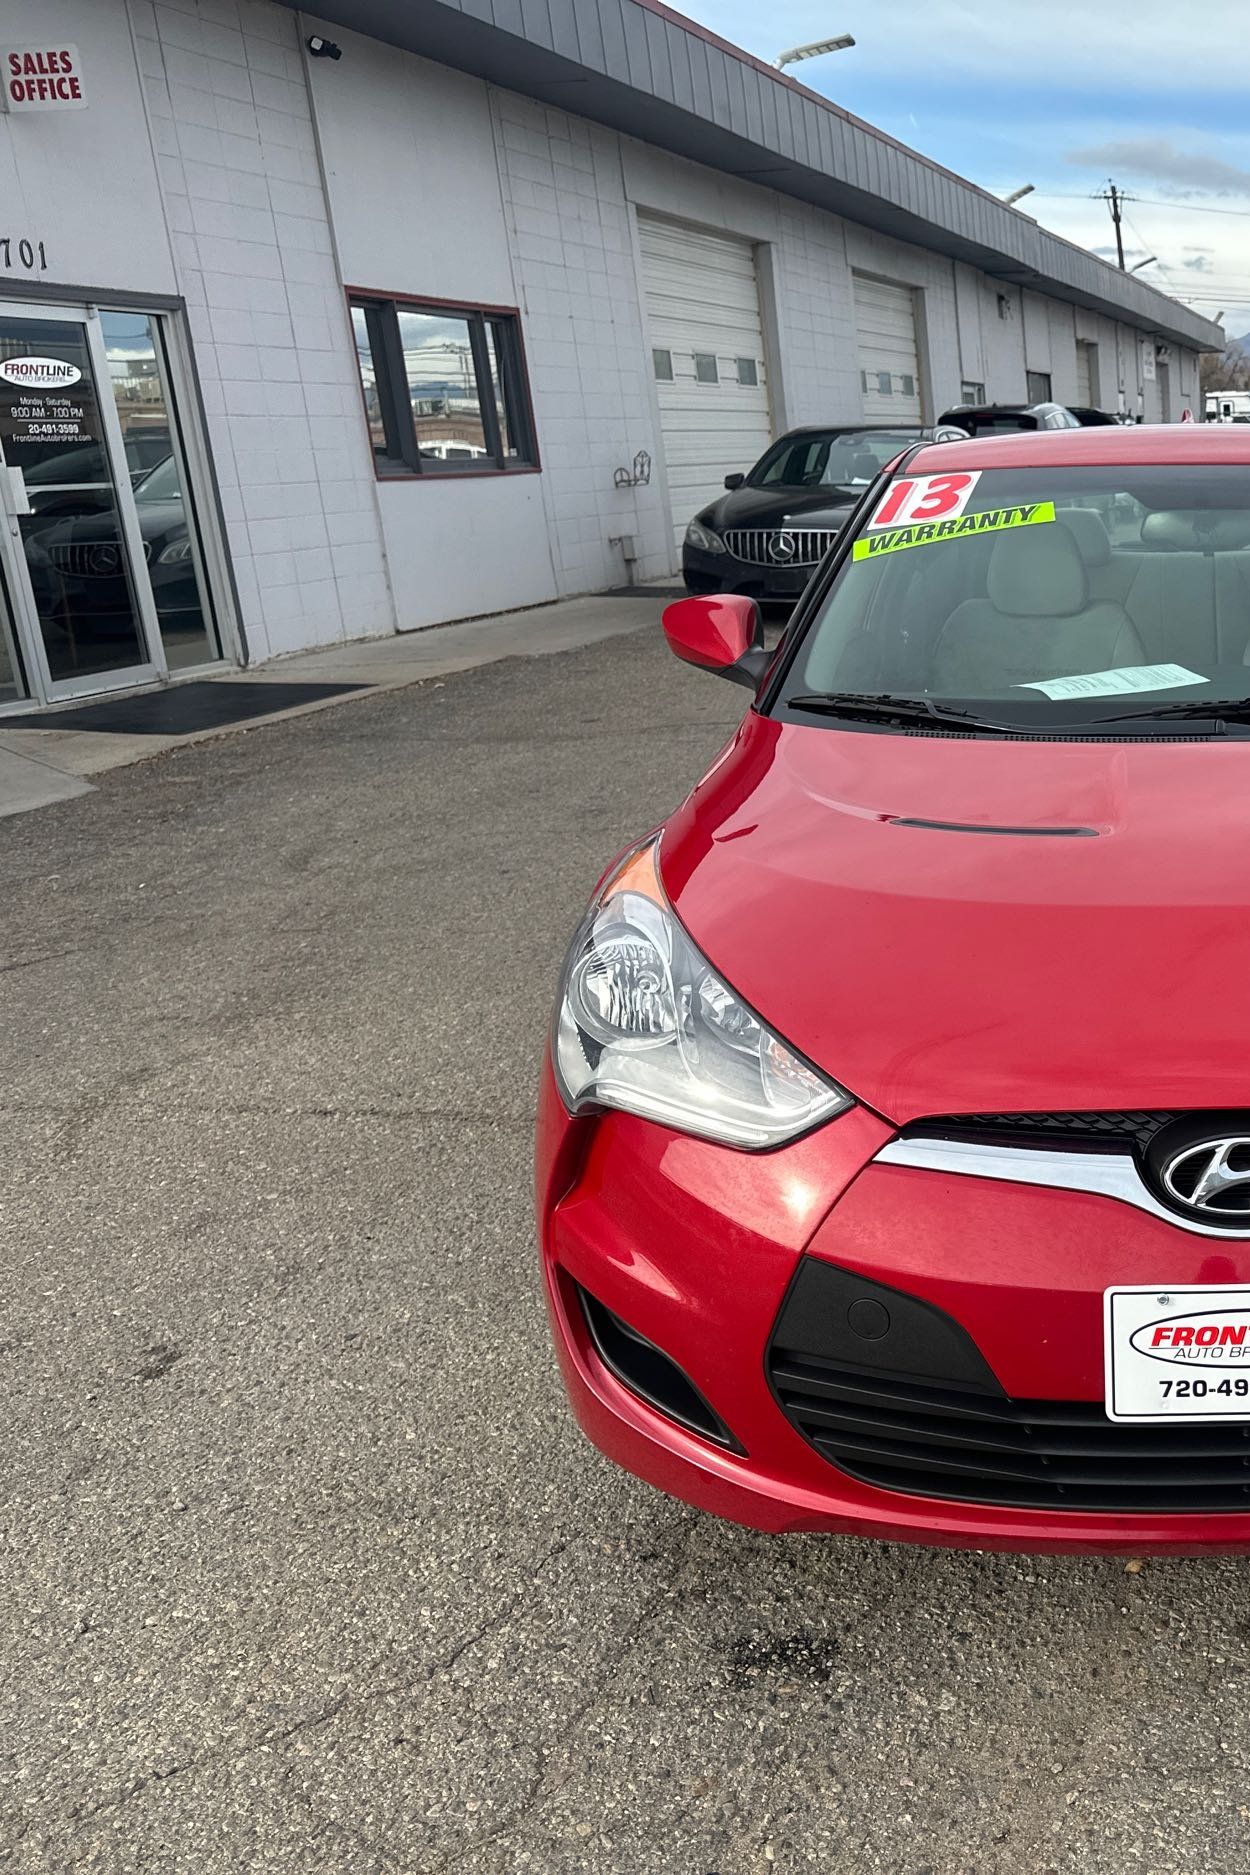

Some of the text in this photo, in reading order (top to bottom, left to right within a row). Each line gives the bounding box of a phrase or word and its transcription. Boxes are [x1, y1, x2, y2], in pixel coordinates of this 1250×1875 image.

[8, 50, 72, 76] SALES
[9, 77, 82, 102] OFFICE
[4, 363, 74, 377] FRONTLINE
[19, 396, 42, 407] Monday
[45, 396, 71, 408] Saturday
[31, 407, 46, 418] AM
[70, 407, 84, 418] PM
[873, 473, 975, 525] 13
[868, 504, 1041, 554] WARRANTY
[1173, 1346, 1223, 1359] AUTO
